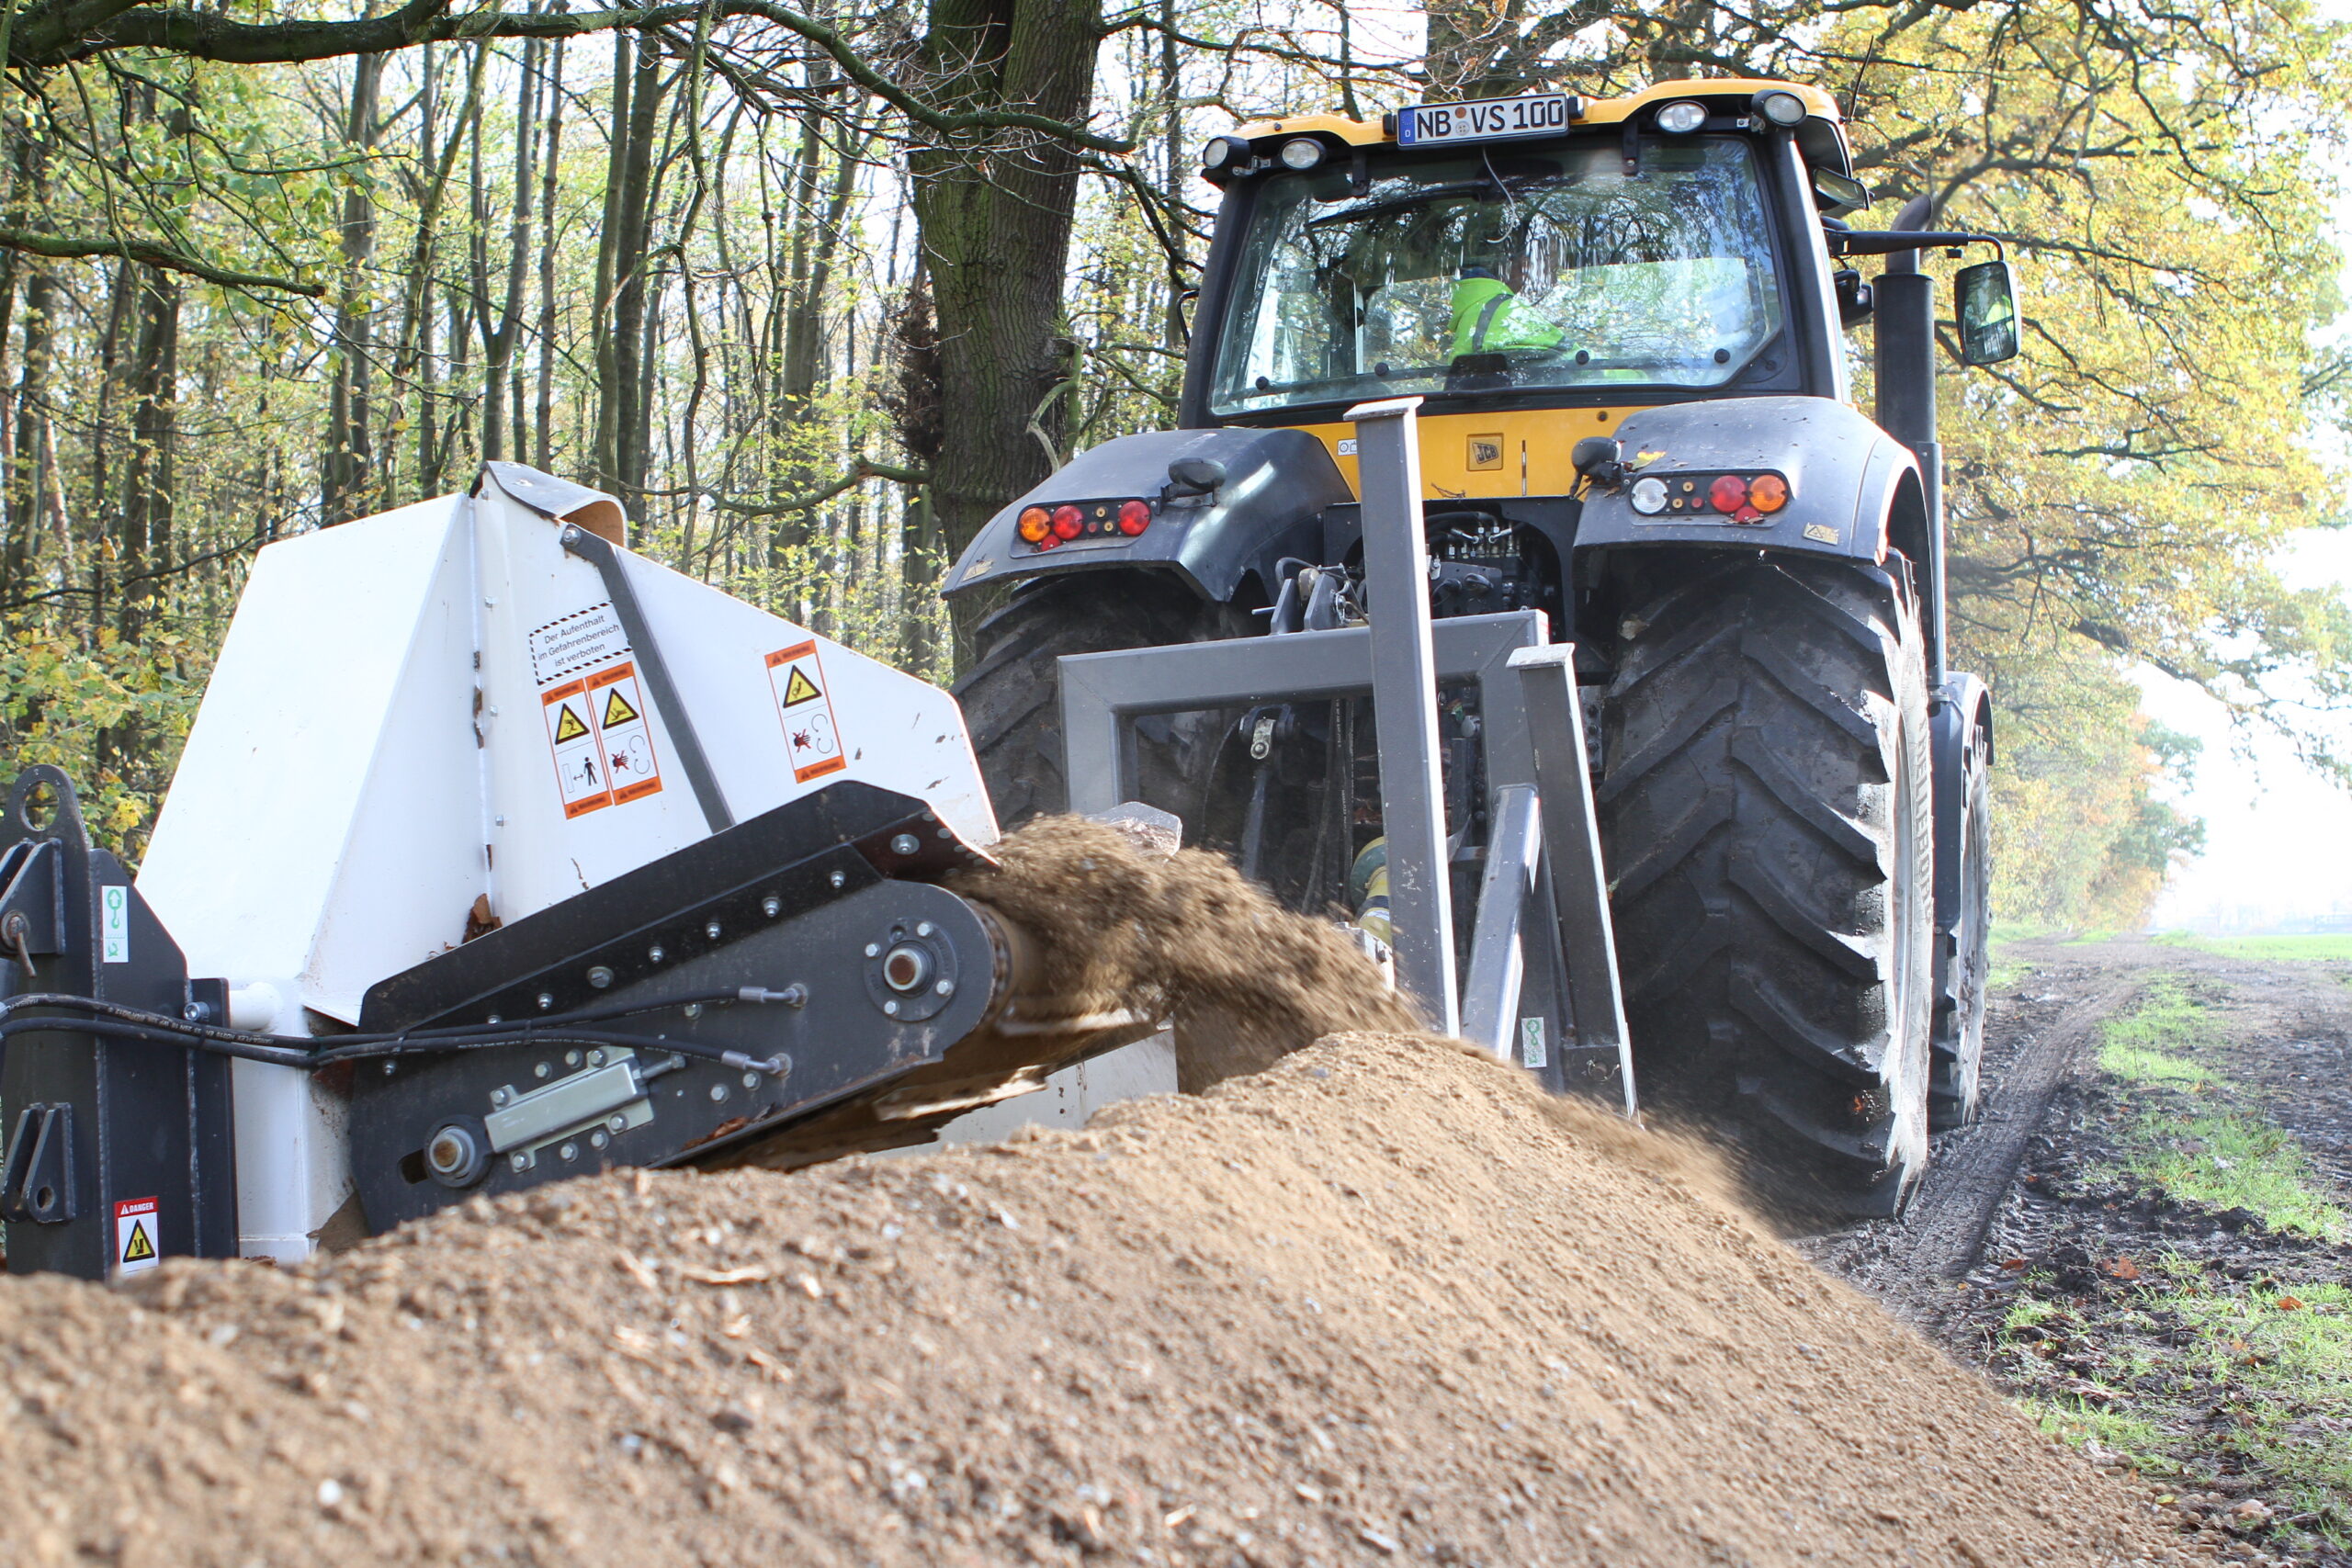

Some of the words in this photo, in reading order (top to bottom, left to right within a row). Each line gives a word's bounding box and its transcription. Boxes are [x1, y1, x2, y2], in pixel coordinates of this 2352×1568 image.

[1405, 130, 1411, 138] D
[1417, 110, 1452, 139] NB
[1471, 105, 1506, 133] VS
[1513, 99, 1563, 130] 100
[1476, 445, 1498, 461] JCB
[537, 652, 548, 660] im
[548, 624, 620, 656] Gefahrenbereich
[544, 633, 559, 644] Der
[560, 615, 605, 637] Aufenthalt
[554, 658, 566, 667] ist
[567, 643, 606, 663] verboten
[130, 1201, 154, 1213] DANGER
